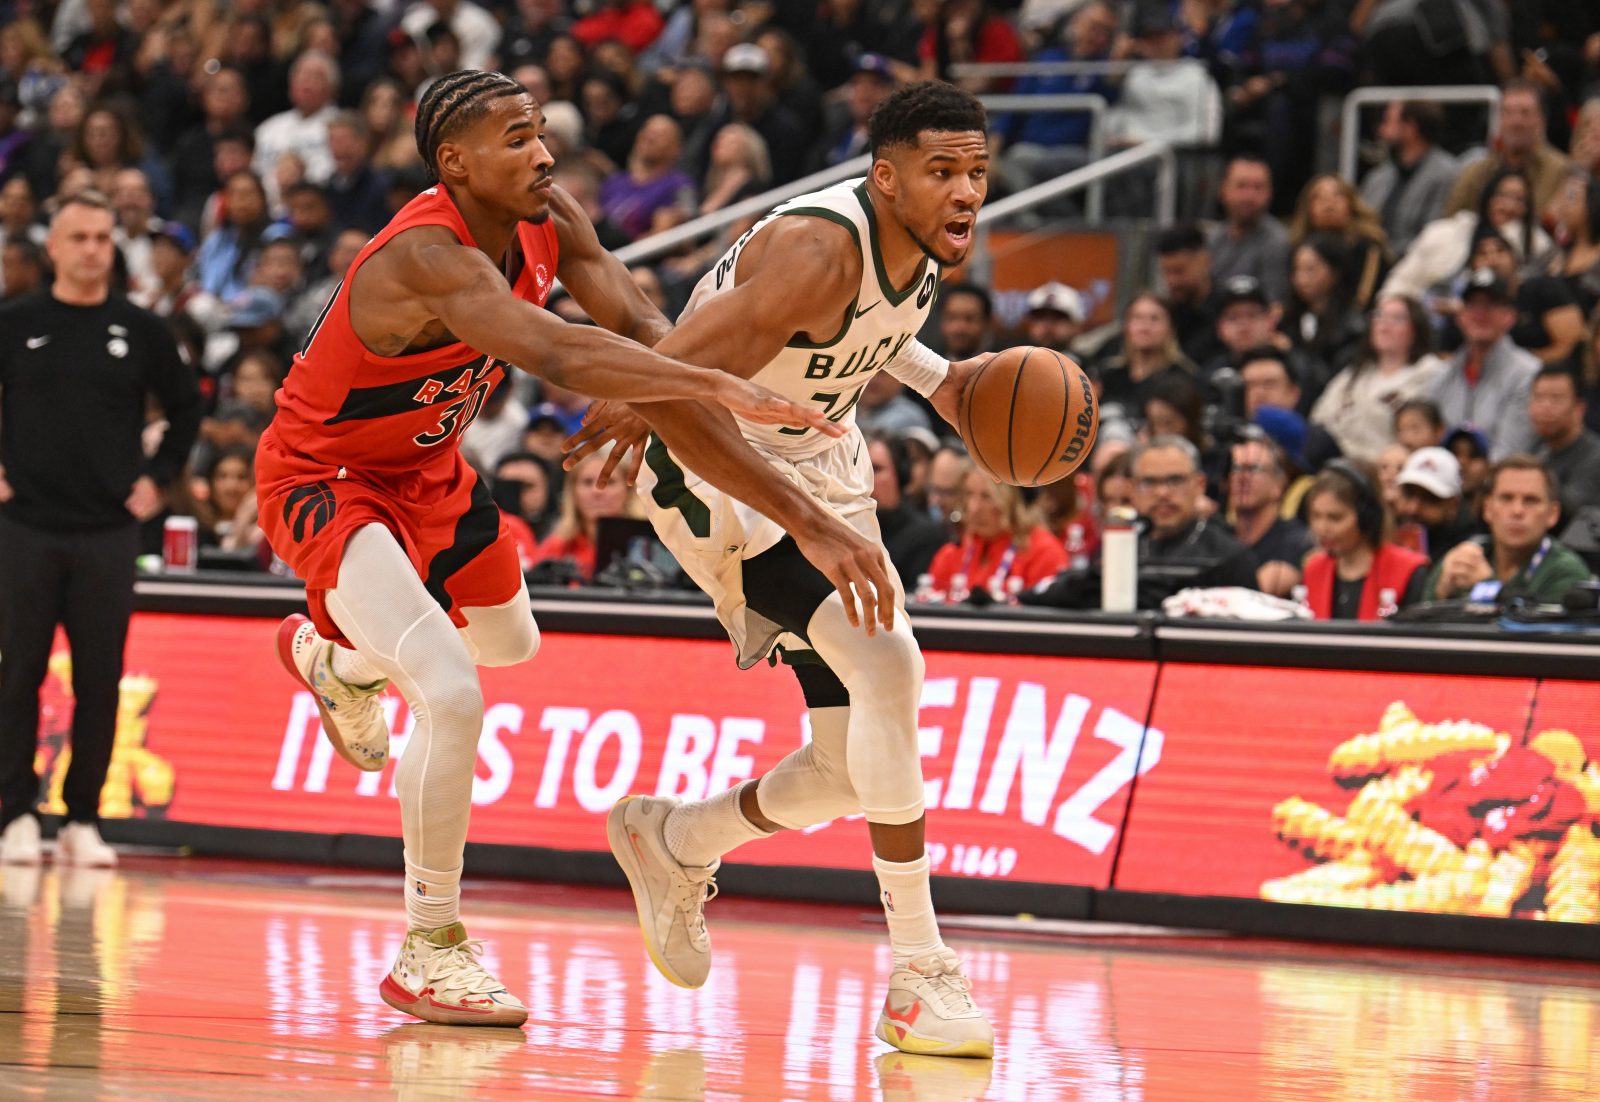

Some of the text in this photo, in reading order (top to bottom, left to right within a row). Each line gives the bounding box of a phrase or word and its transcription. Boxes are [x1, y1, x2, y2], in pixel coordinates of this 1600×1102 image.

[804, 333, 911, 379] BUCK
[1059, 374, 1093, 463] Wilson
[533, 706, 642, 813] TO
[654, 713, 765, 803] BE
[801, 676, 1164, 856] EINZ
